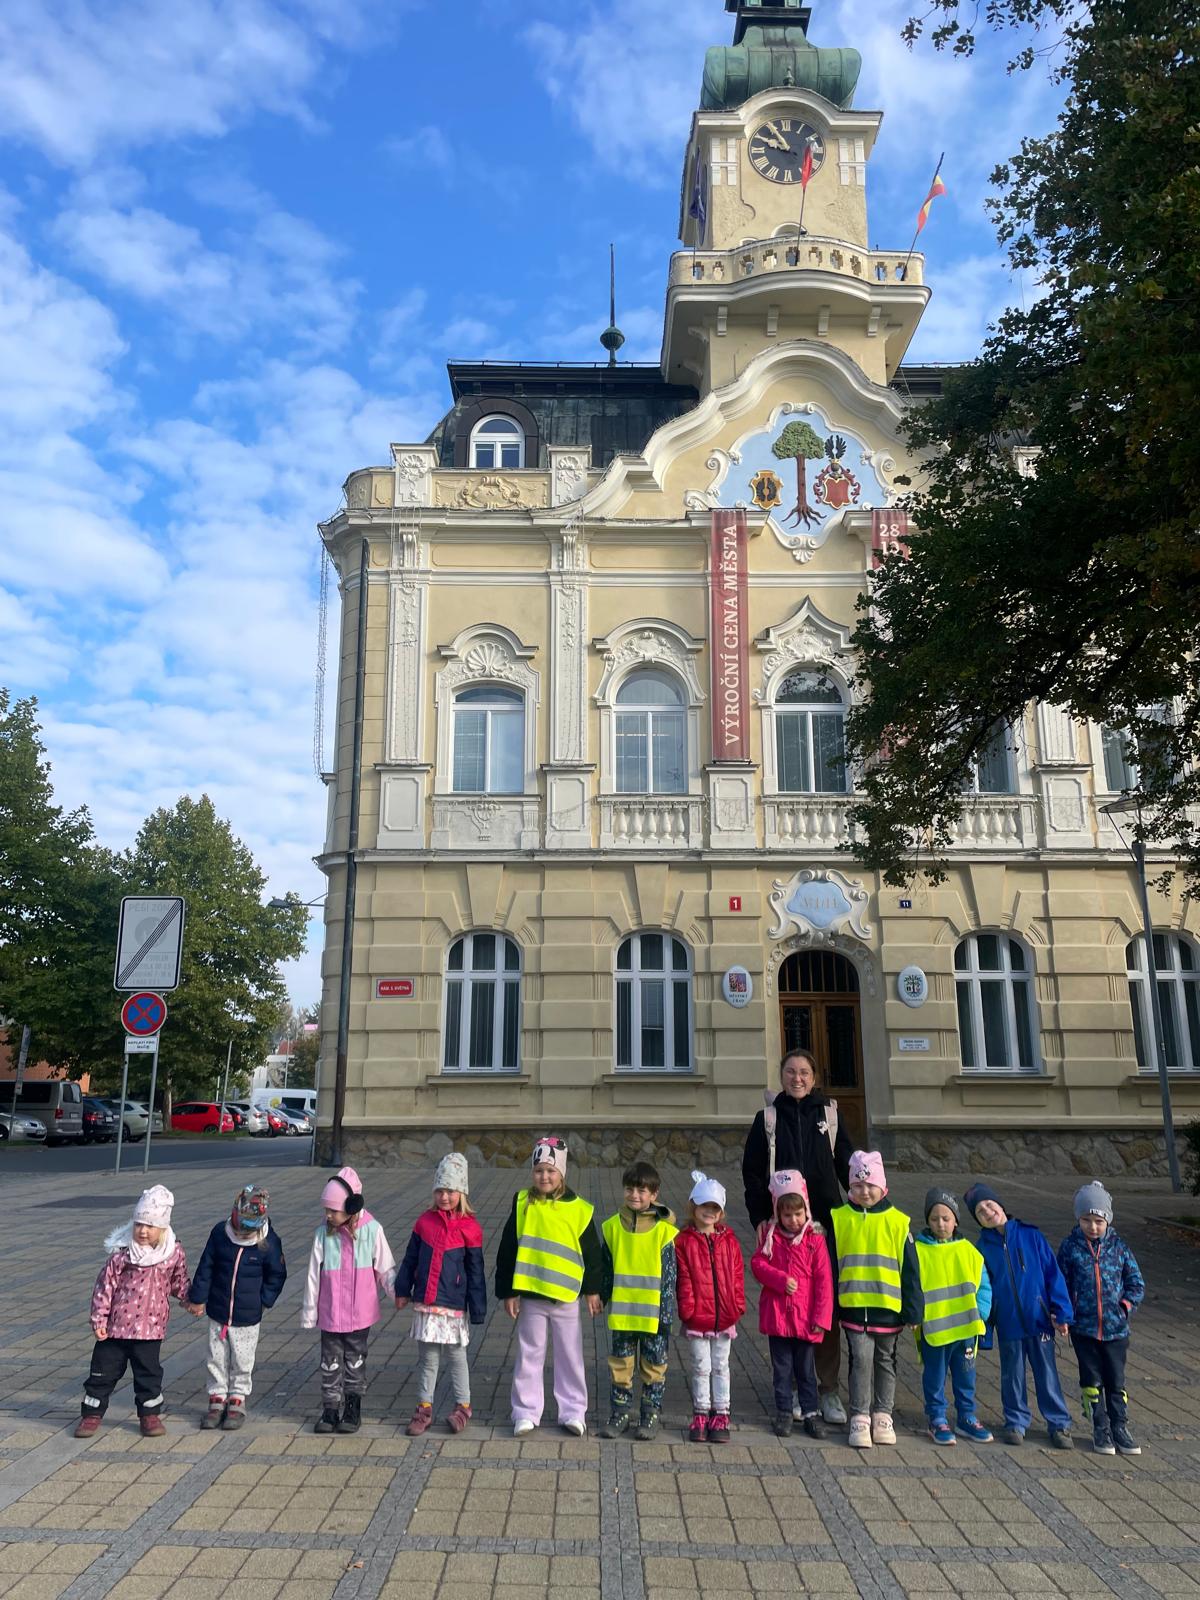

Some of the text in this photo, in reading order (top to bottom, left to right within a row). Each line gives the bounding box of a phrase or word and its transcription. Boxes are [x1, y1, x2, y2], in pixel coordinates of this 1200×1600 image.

[879, 523, 901, 537] 28
[719, 523, 740, 746] VÝROČNÍ CENA MĚSTA
[732, 899, 738, 909] 1
